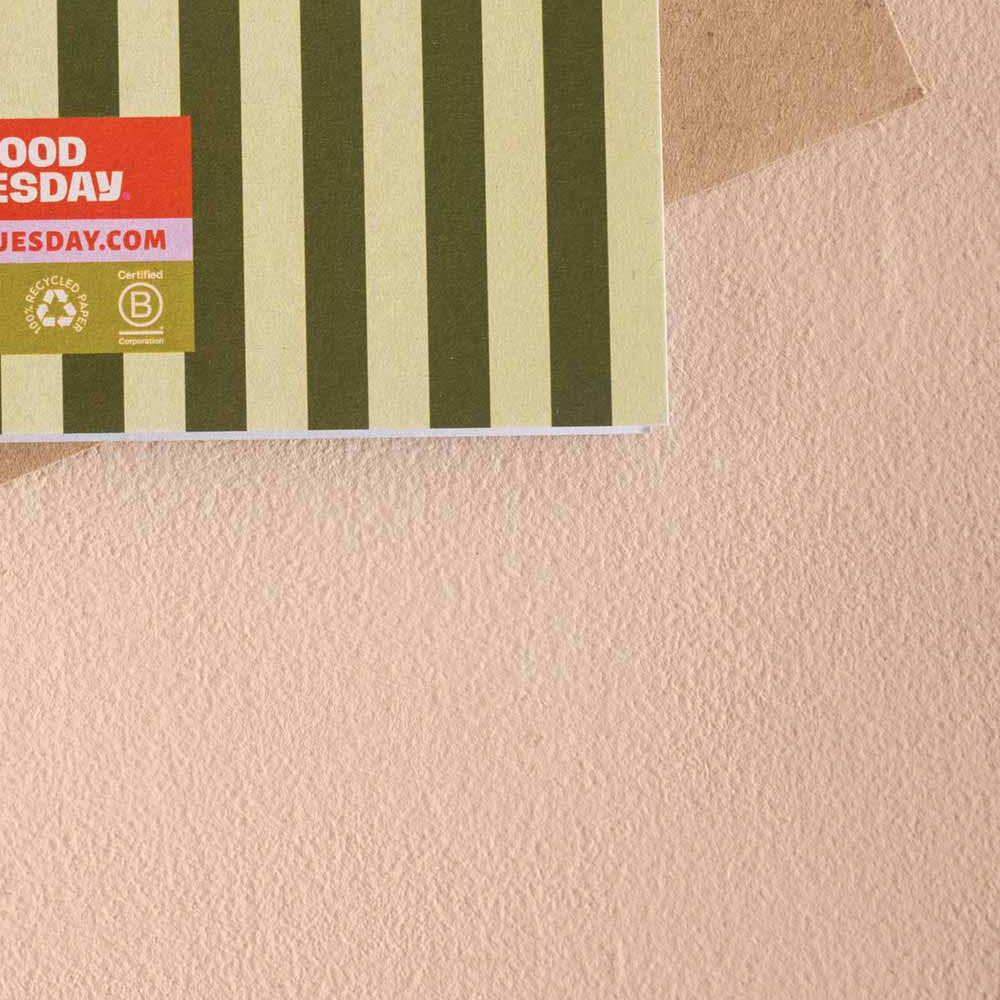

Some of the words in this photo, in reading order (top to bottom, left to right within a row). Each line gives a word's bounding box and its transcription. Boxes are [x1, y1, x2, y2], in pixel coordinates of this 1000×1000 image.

[25, 275, 80, 304] RECYCLED
[118, 270, 164, 280] Certified
[24, 305, 41, 335] 100%
[73, 294, 89, 333] PAPER
